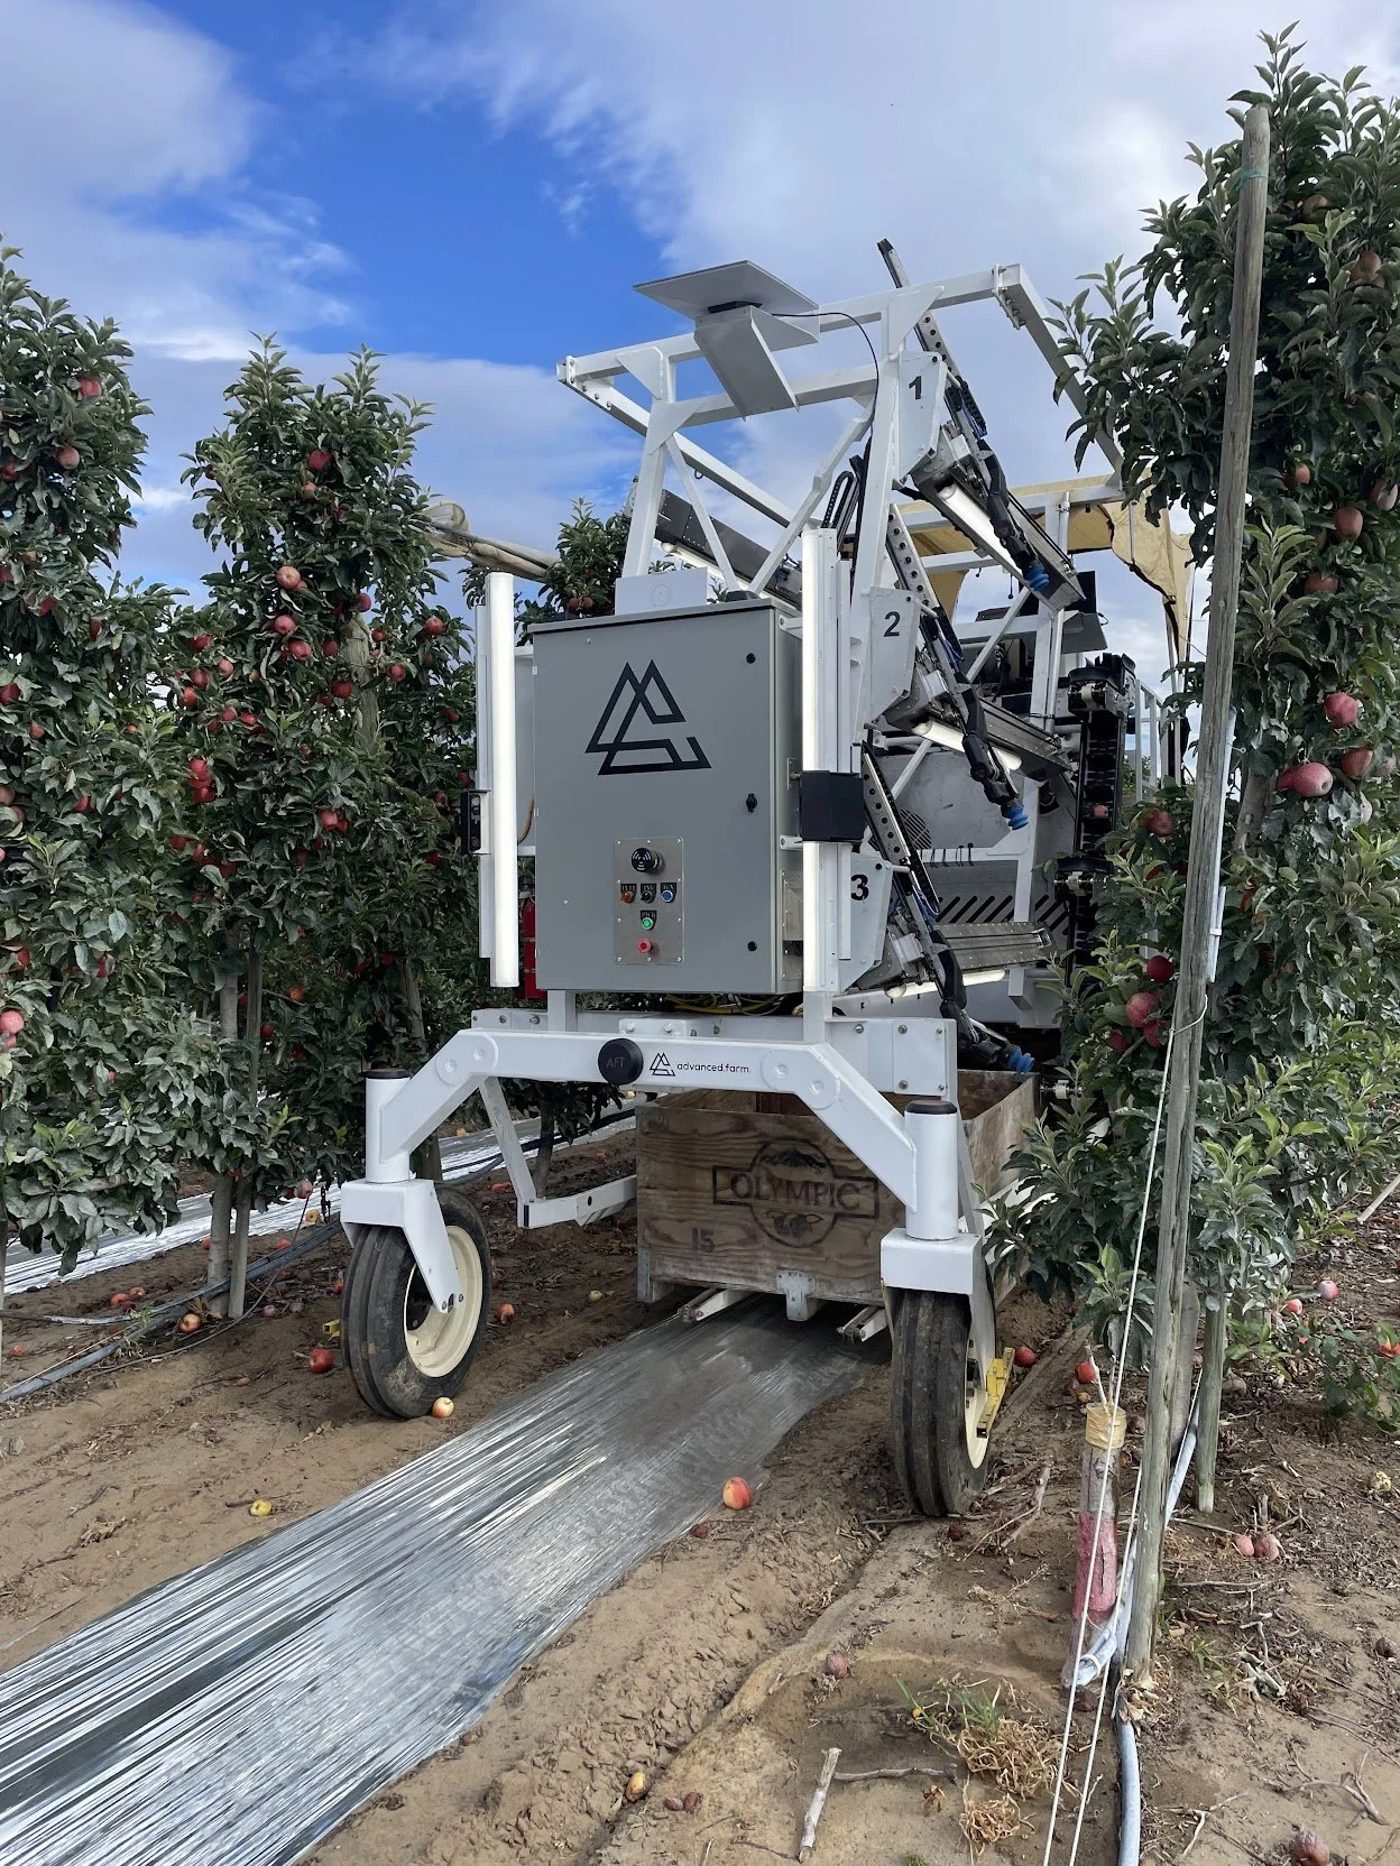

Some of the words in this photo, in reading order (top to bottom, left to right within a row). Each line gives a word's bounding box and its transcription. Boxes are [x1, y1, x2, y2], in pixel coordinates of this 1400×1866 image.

[908, 375, 921, 400] 1
[884, 611, 900, 637] 2
[851, 874, 869, 901] 3
[606, 1057, 625, 1068] AFT
[731, 1173, 859, 1210] OLYMPIC
[692, 1228, 715, 1253] 15
